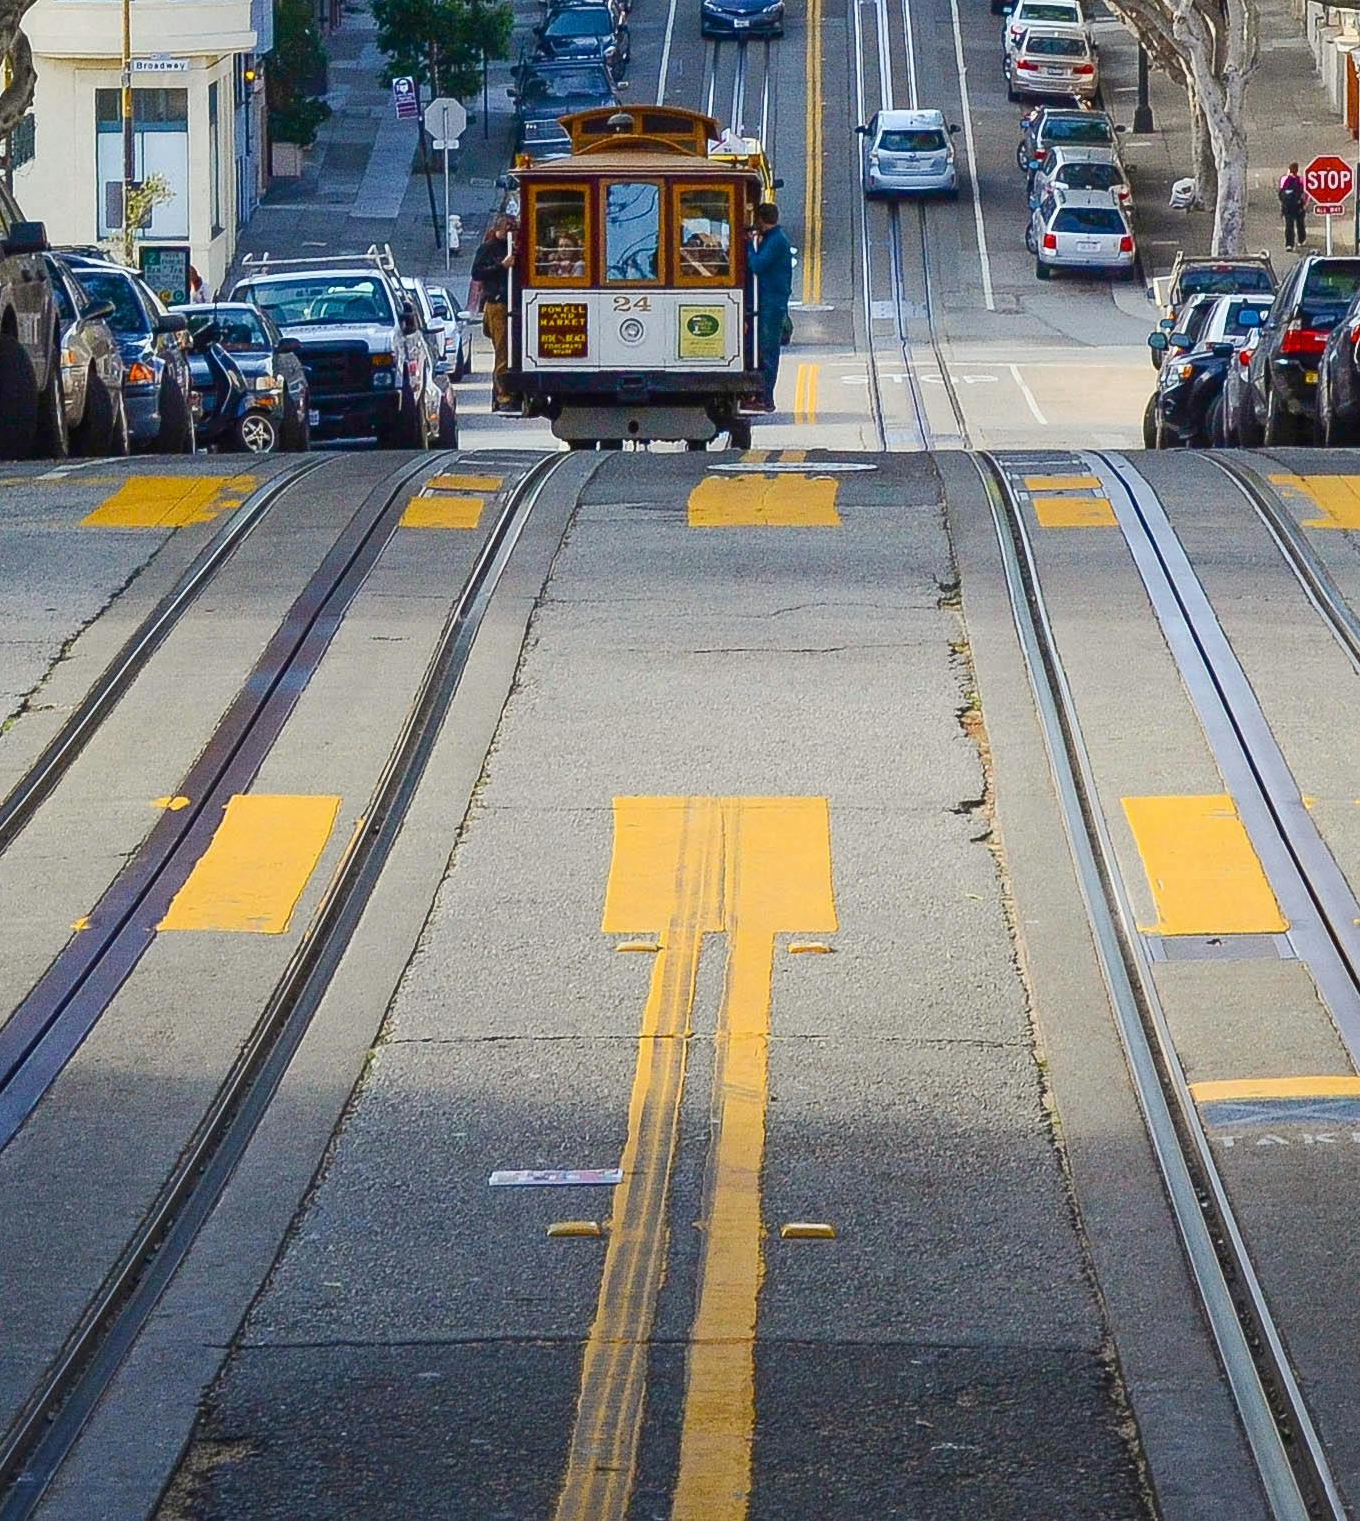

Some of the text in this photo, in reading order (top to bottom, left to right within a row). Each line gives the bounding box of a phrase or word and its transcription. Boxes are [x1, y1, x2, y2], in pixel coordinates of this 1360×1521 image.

[136, 62, 186, 70] Broadway
[1308, 170, 1351, 190] STOP
[613, 296, 652, 312] 24
[841, 374, 999, 384] STOP
